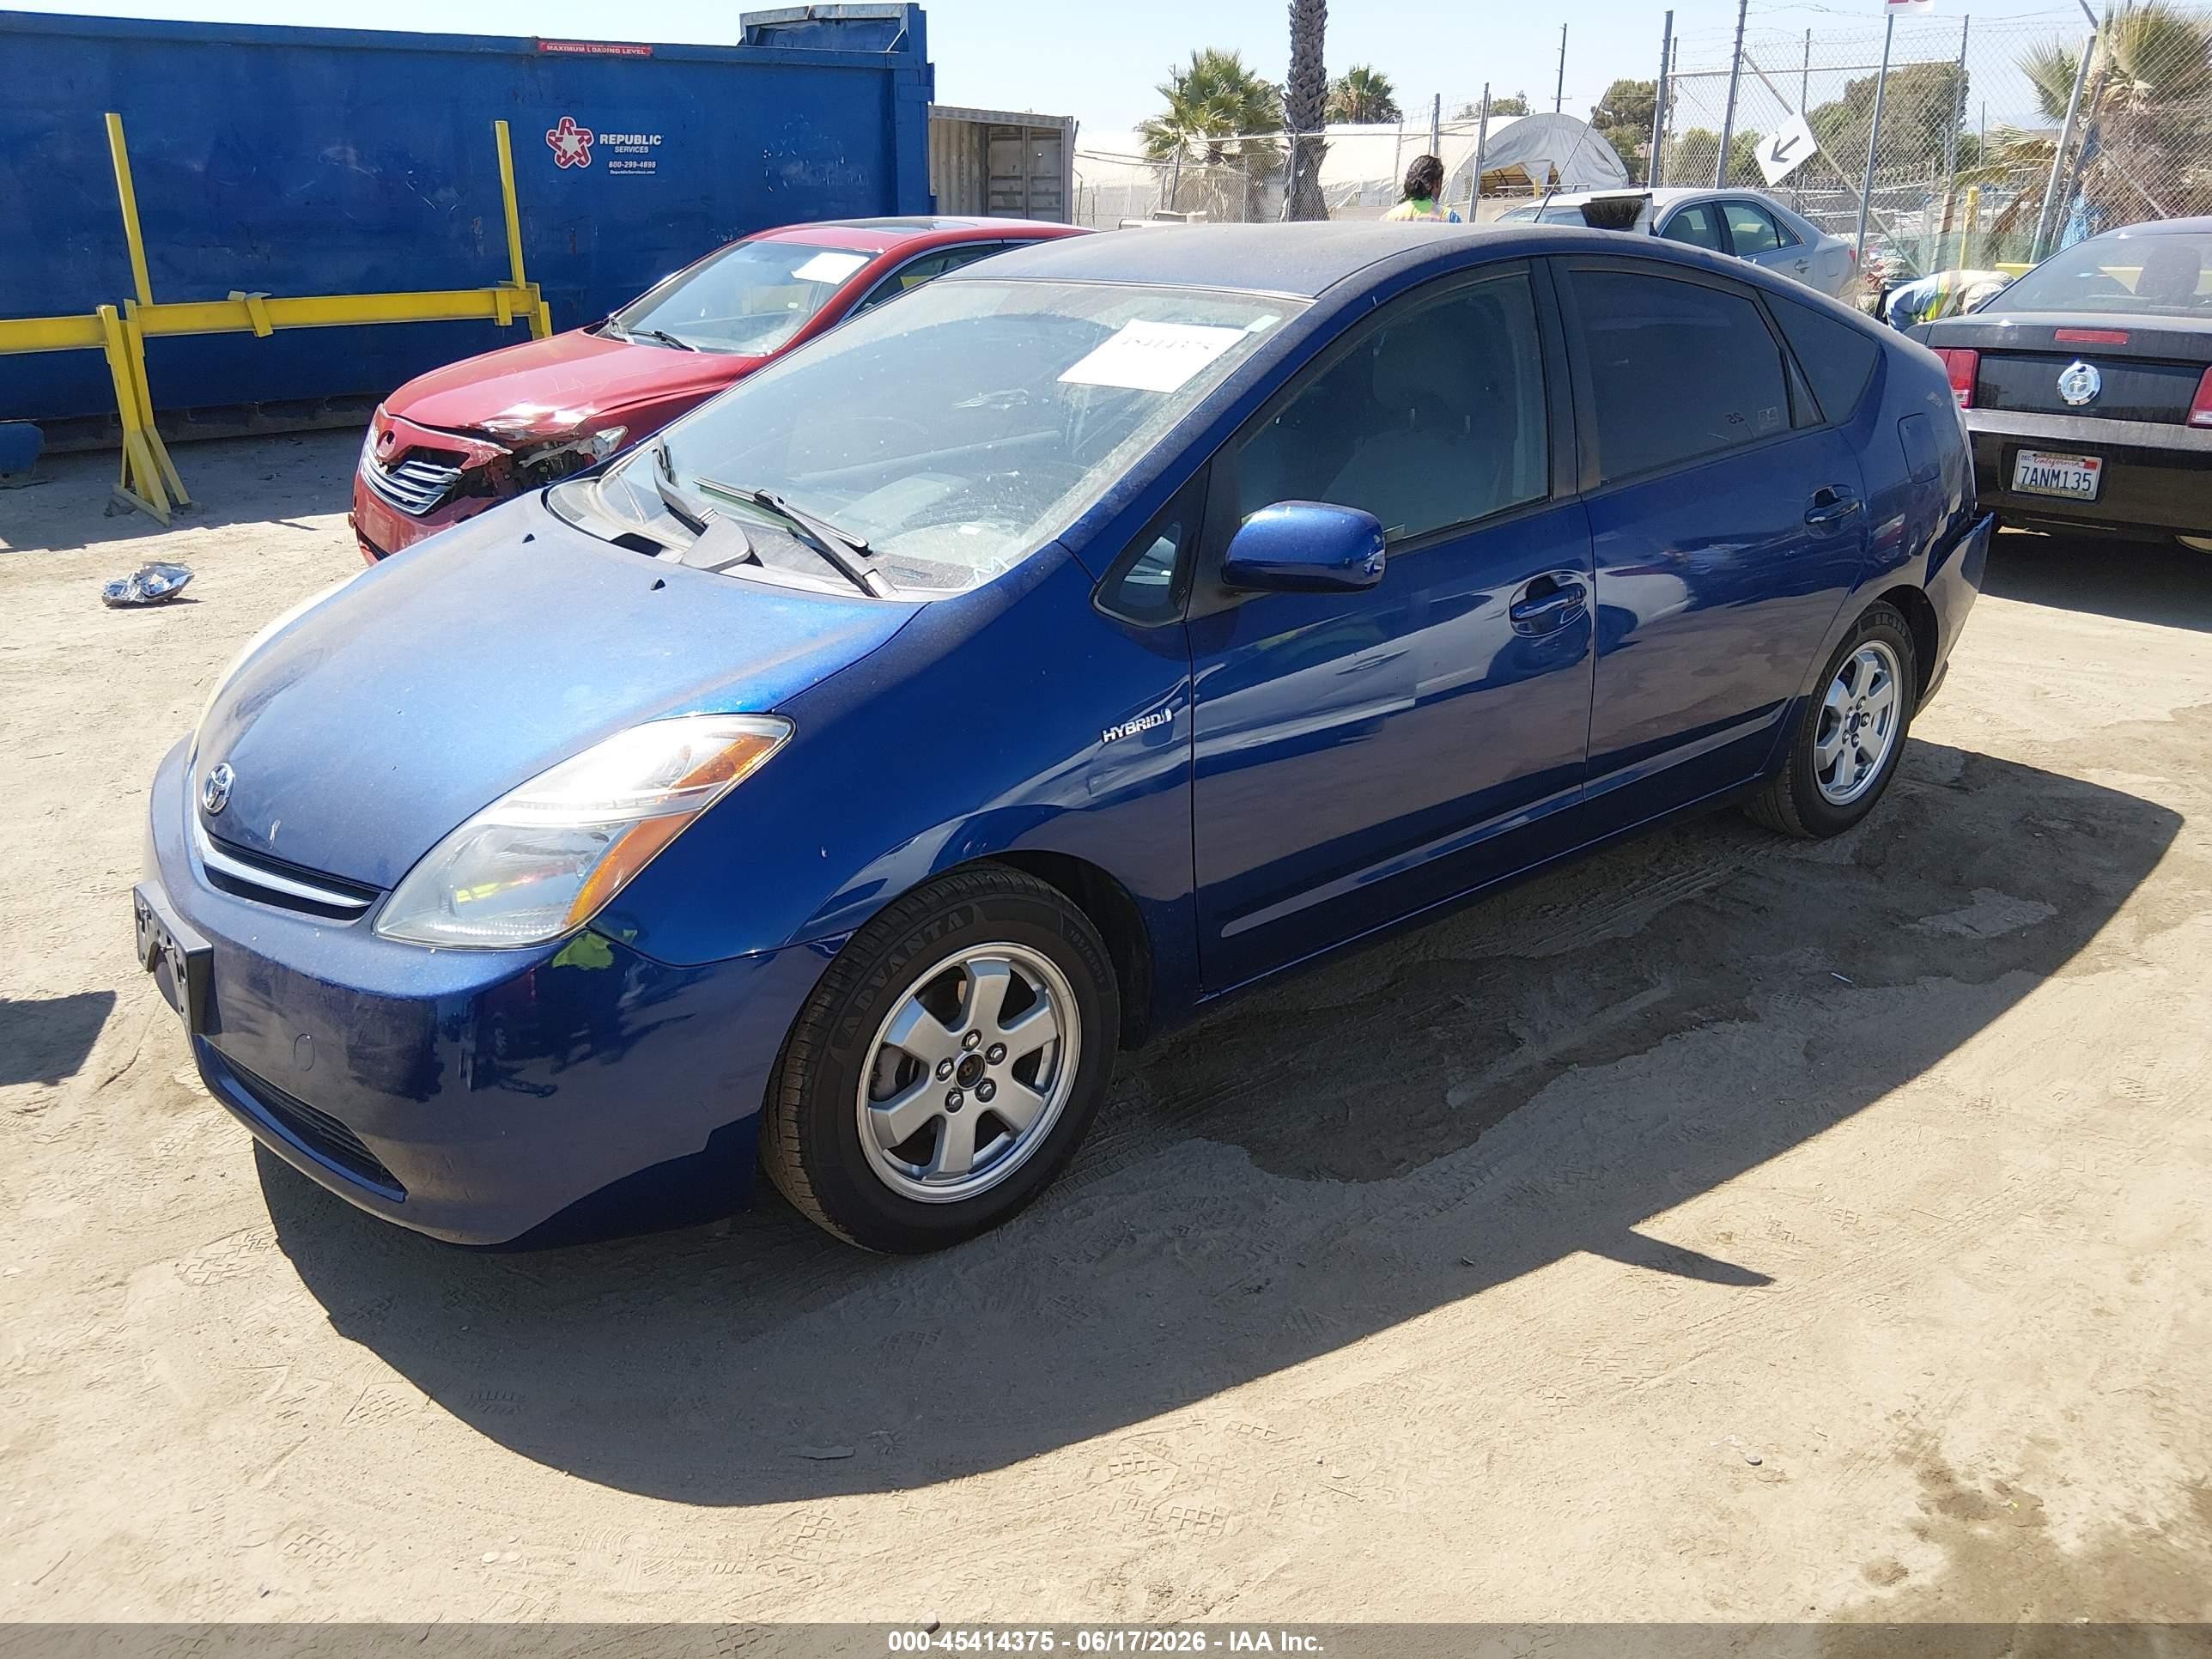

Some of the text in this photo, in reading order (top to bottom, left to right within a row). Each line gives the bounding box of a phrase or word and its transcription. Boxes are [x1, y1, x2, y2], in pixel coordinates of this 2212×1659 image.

[547, 45, 586, 53] MAXIMUM
[599, 134, 661, 145] REPUBLIC
[2033, 457, 2080, 468] California
[2021, 466, 2092, 492] 7ANM135
[1102, 712, 1166, 743] HYBRID
[842, 911, 967, 1038] ADVANTA
